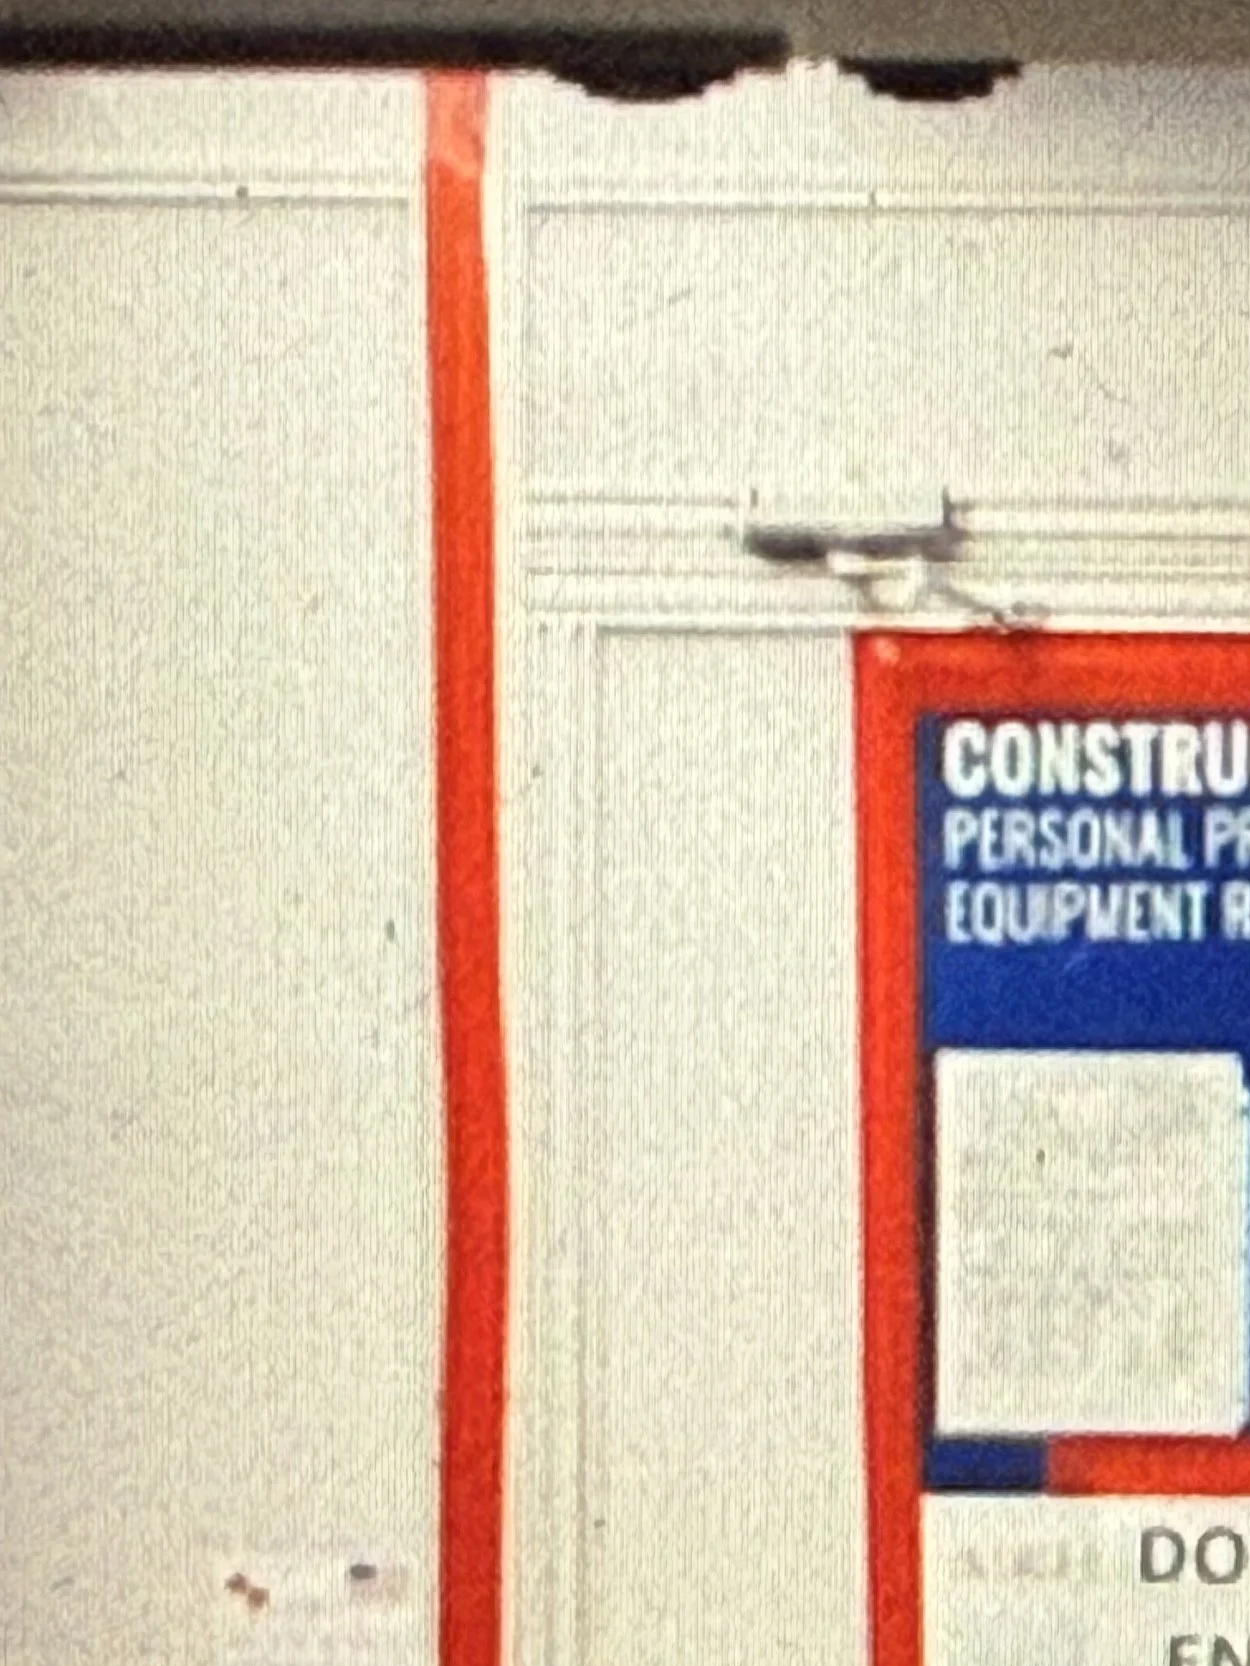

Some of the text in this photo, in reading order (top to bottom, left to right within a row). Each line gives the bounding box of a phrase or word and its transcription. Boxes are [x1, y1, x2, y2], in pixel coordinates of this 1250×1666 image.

[944, 808, 1190, 871] PERSONAL
[946, 880, 1208, 946] EQUIPMENT
[1140, 1526, 1247, 1584] DO
